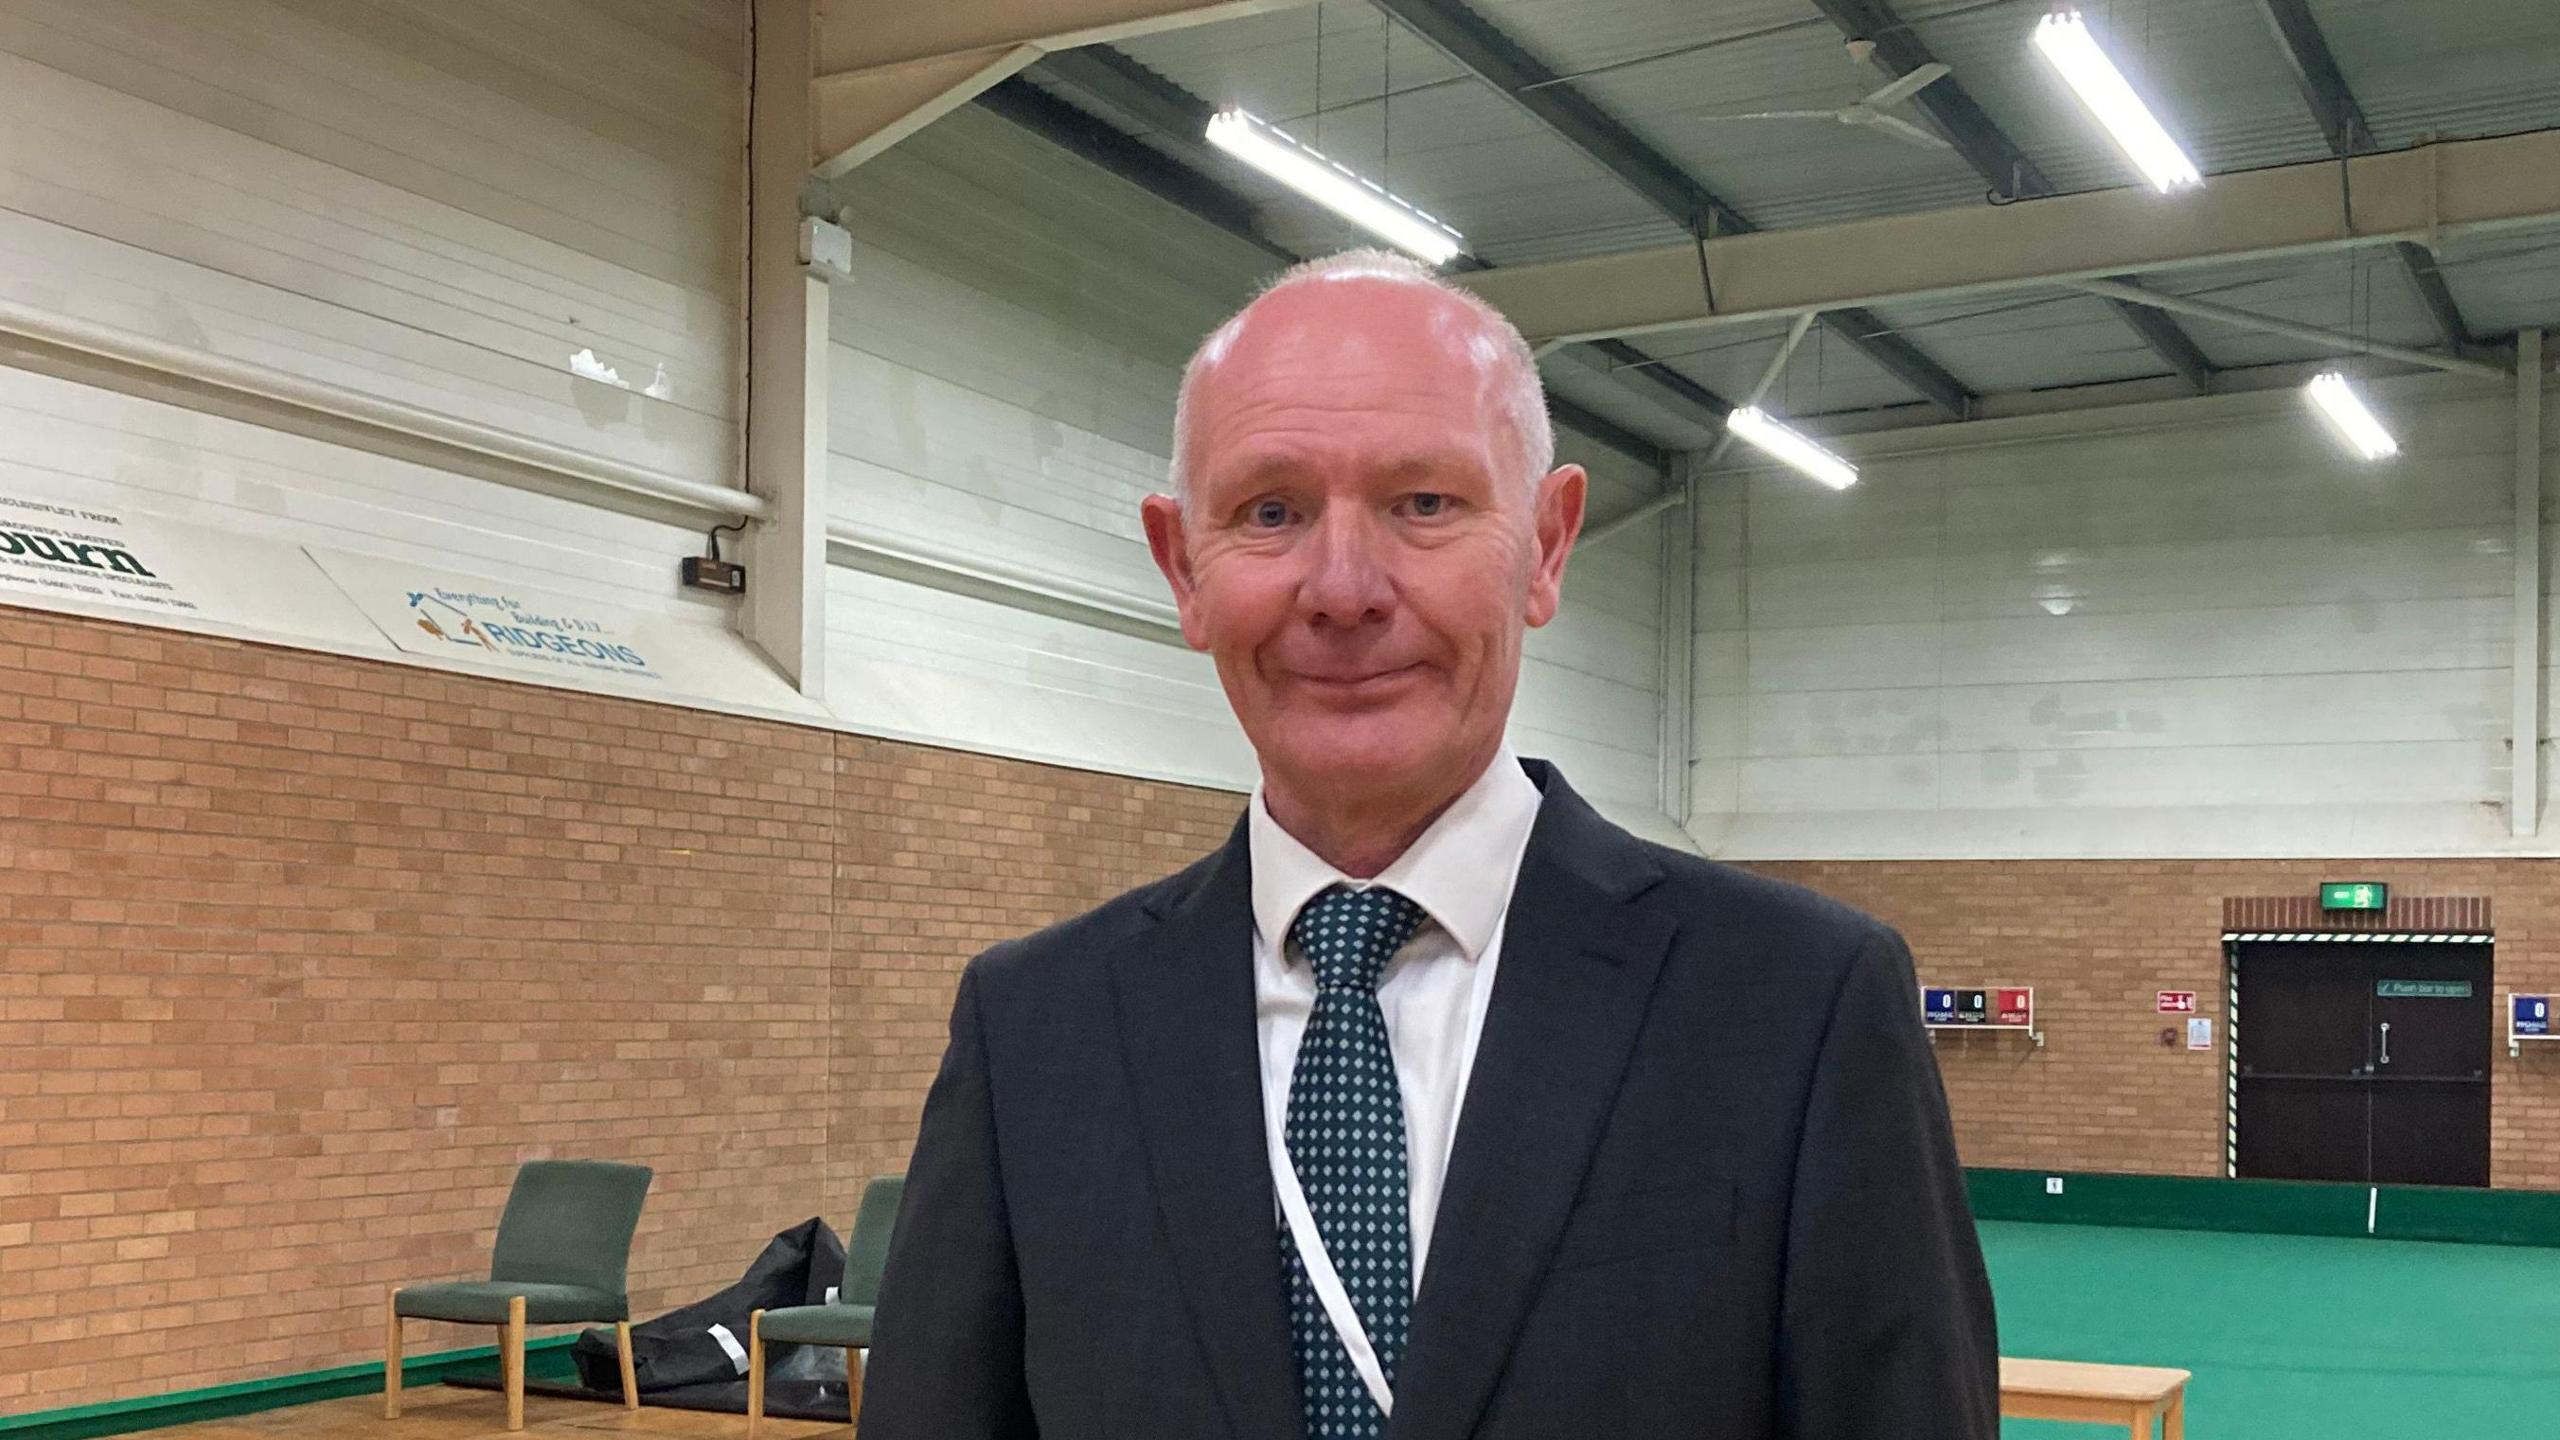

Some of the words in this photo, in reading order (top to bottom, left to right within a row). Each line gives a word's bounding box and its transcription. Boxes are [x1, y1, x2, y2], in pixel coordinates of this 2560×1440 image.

[511, 611, 564, 632] Building
[481, 621, 645, 666] RIDGEONS
[1942, 994, 1951, 1009] 0
[1973, 994, 1983, 1009] 0
[2016, 995, 2026, 1009] 0
[2534, 1002, 2545, 1018] 0
